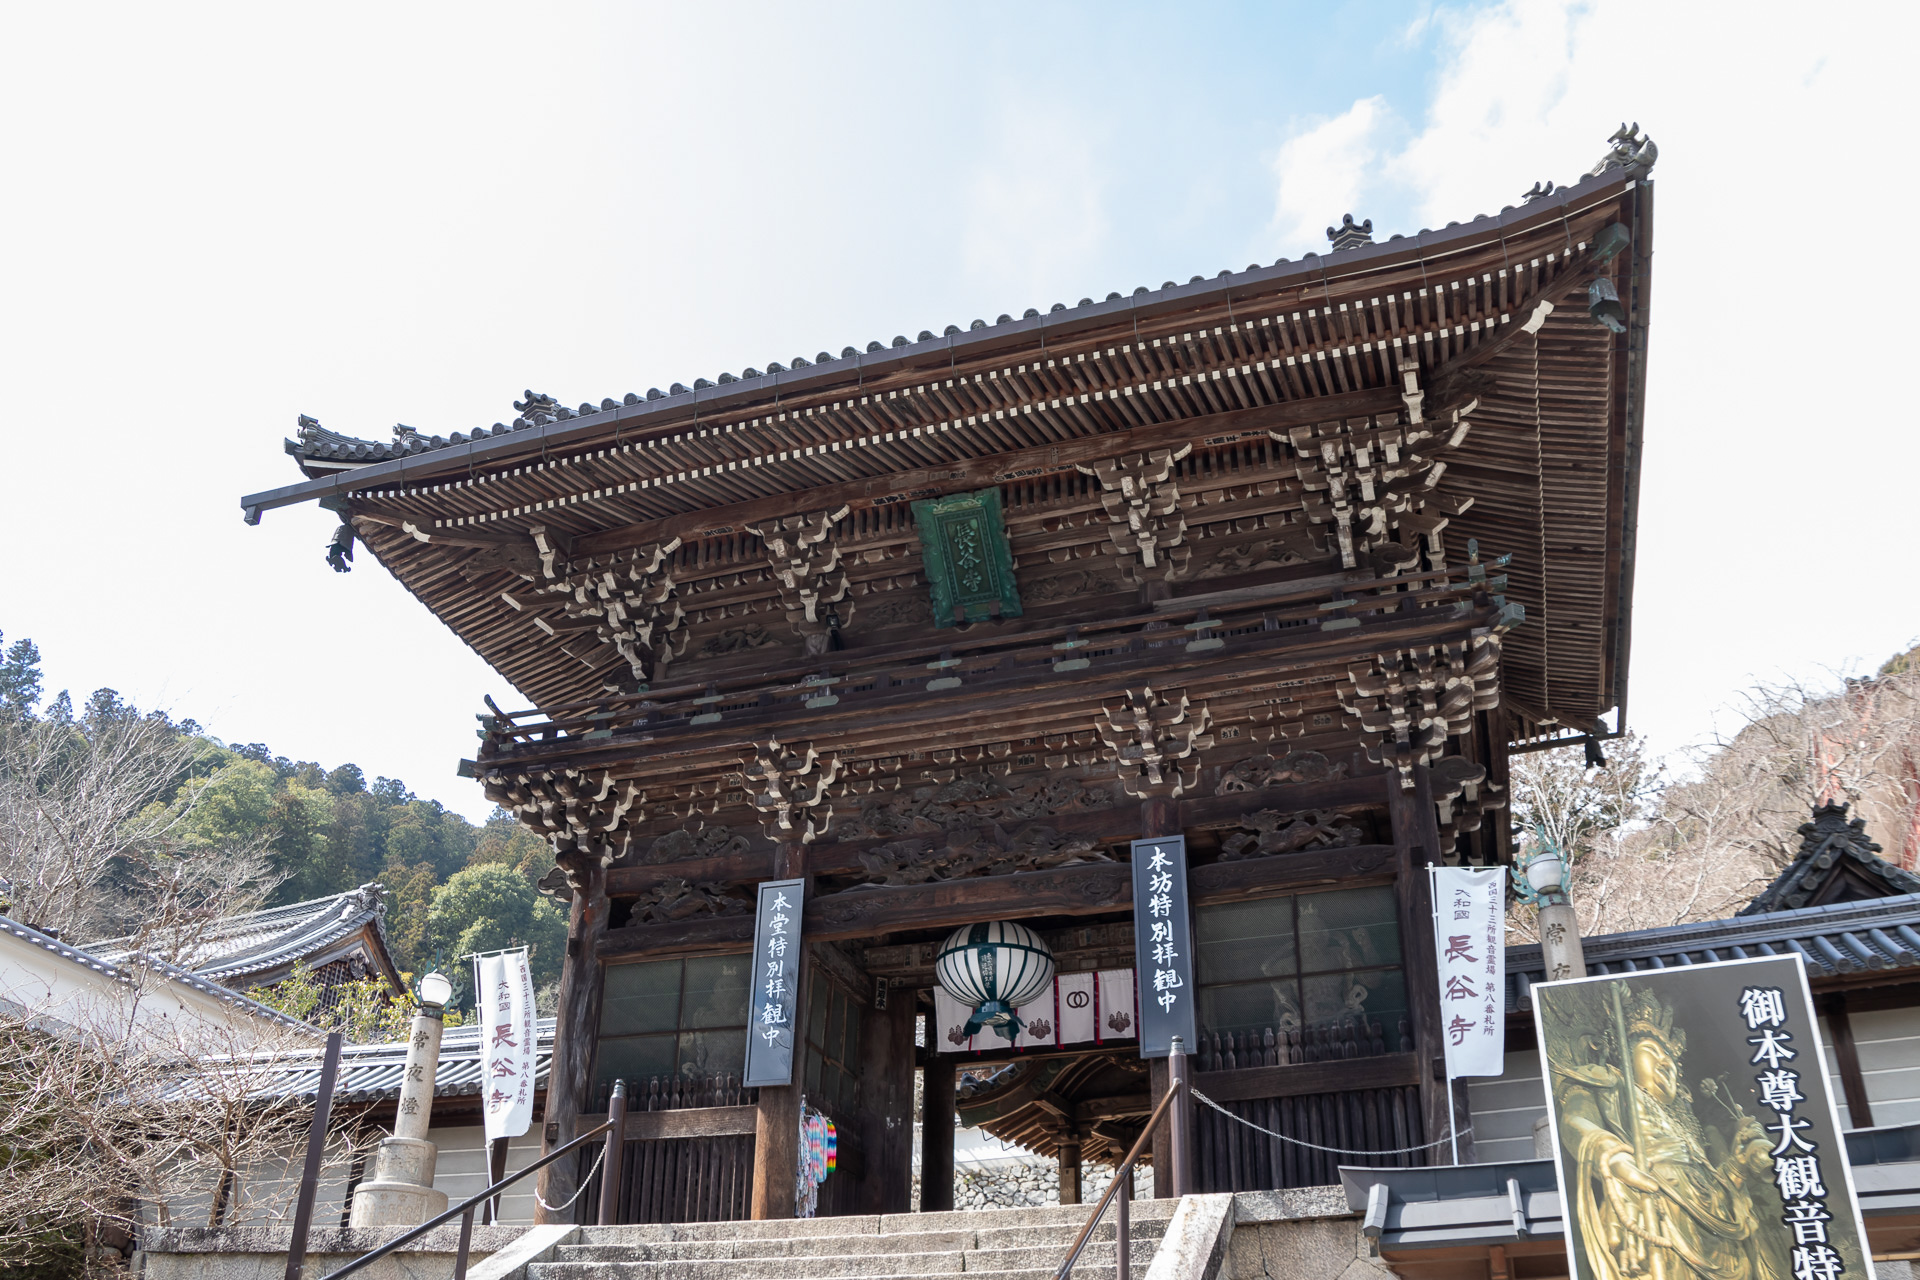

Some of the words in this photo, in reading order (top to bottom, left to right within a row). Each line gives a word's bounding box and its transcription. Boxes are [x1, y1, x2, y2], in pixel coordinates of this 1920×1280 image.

[954, 523, 982, 592] 長谷寺
[760, 892, 792, 1048] 本堂特別拝観中
[1147, 846, 1184, 1014] 本坊特別拝観中
[498, 980, 511, 1012] 大和國
[1445, 934, 1479, 1047] 長谷寺
[1484, 981, 1495, 1037] 第八番札所
[401, 1030, 430, 1117] 常夜燈
[488, 1023, 518, 1114] 長谷寺
[517, 1061, 529, 1105] 第八番札所
[1740, 988, 1843, 1280] 御本尊大観音特
